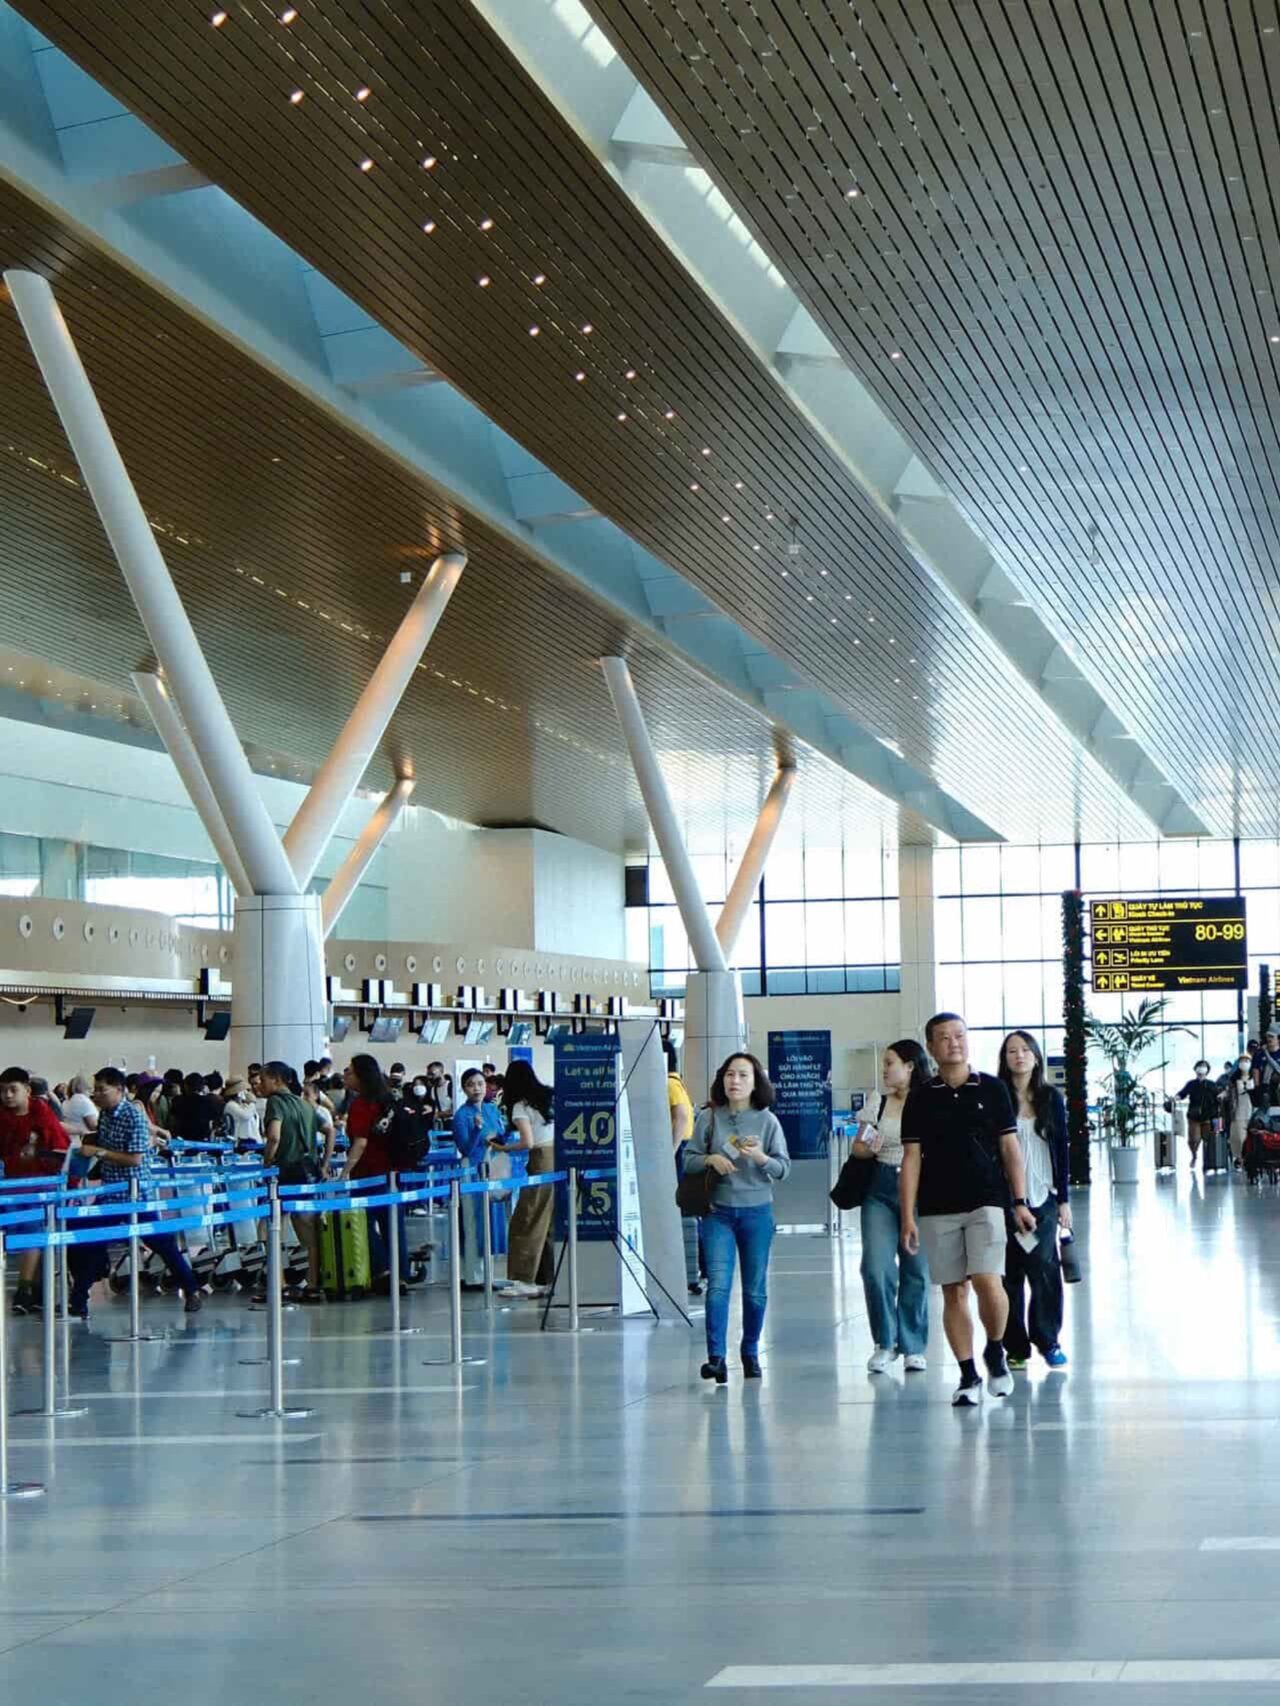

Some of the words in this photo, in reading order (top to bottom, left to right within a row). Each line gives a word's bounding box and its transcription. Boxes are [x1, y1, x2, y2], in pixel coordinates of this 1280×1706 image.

[1195, 924, 1245, 941] 80-99
[1177, 976, 1207, 984] Vietnam
[562, 1111, 615, 1145] 40
